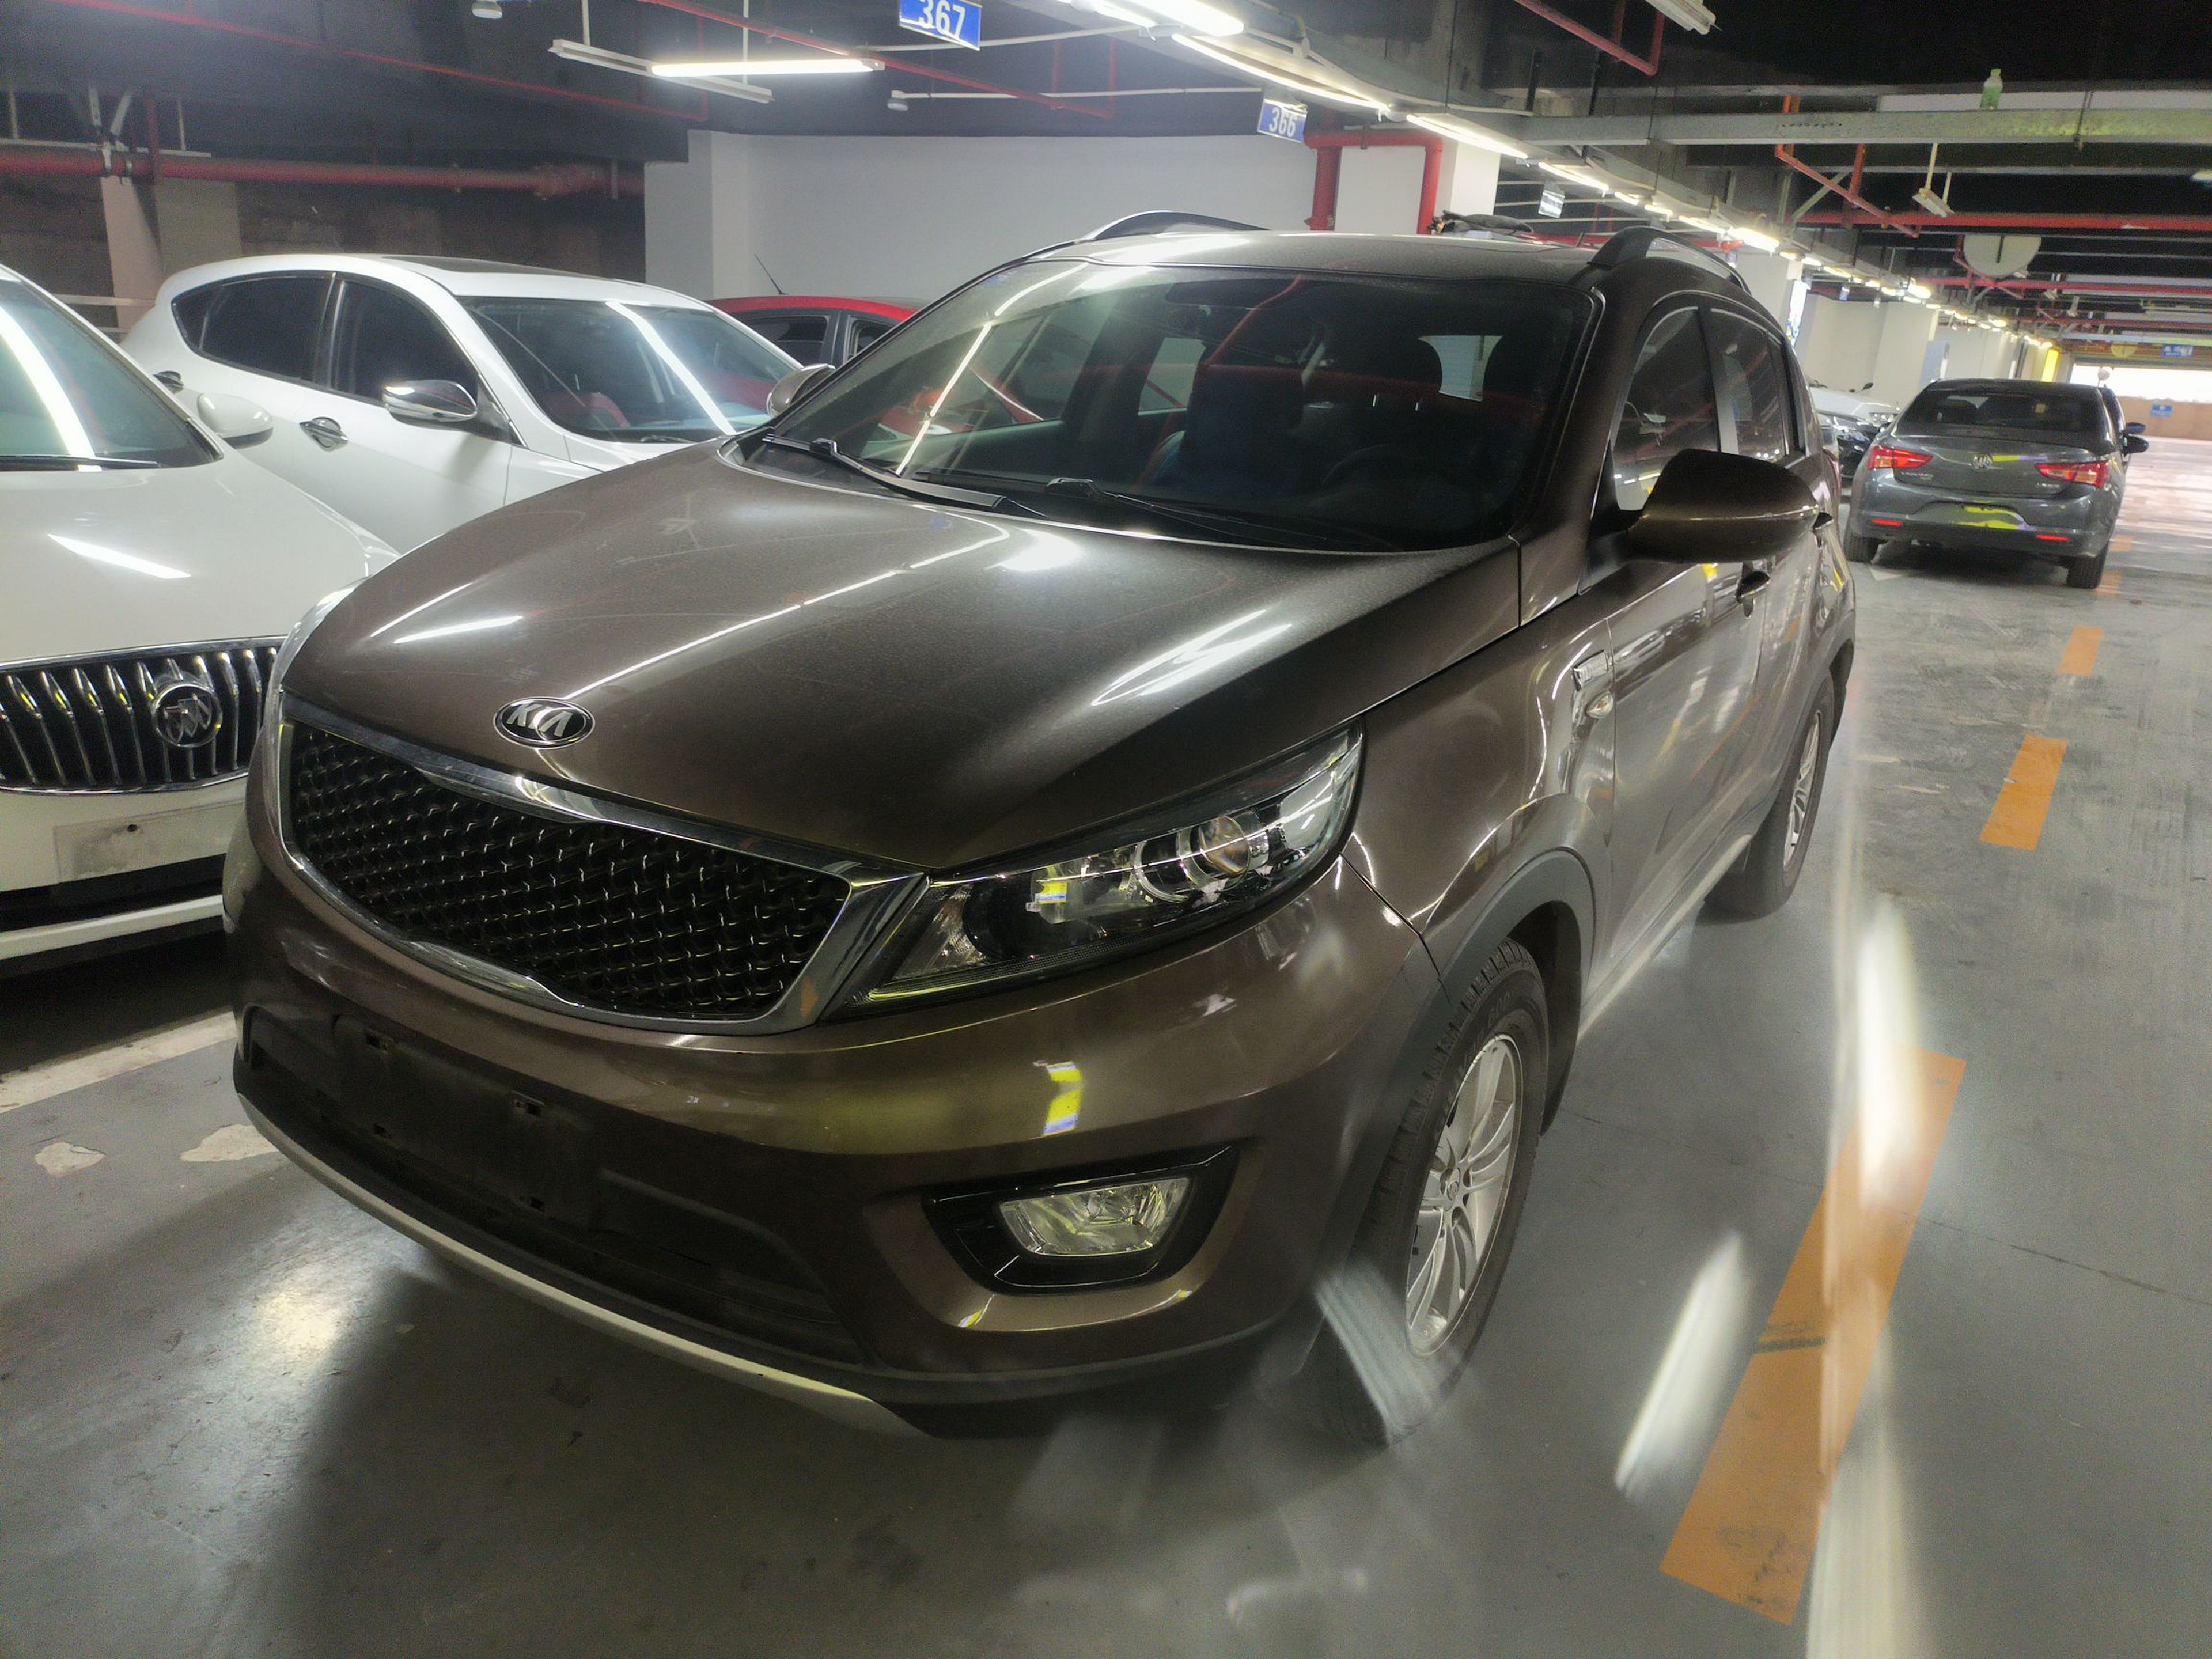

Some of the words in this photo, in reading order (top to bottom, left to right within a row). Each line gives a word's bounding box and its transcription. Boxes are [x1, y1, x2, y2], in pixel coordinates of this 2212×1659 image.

[918, 0, 965, 40] 367
[1268, 107, 1297, 137] 366
[506, 703, 574, 737] KIA
